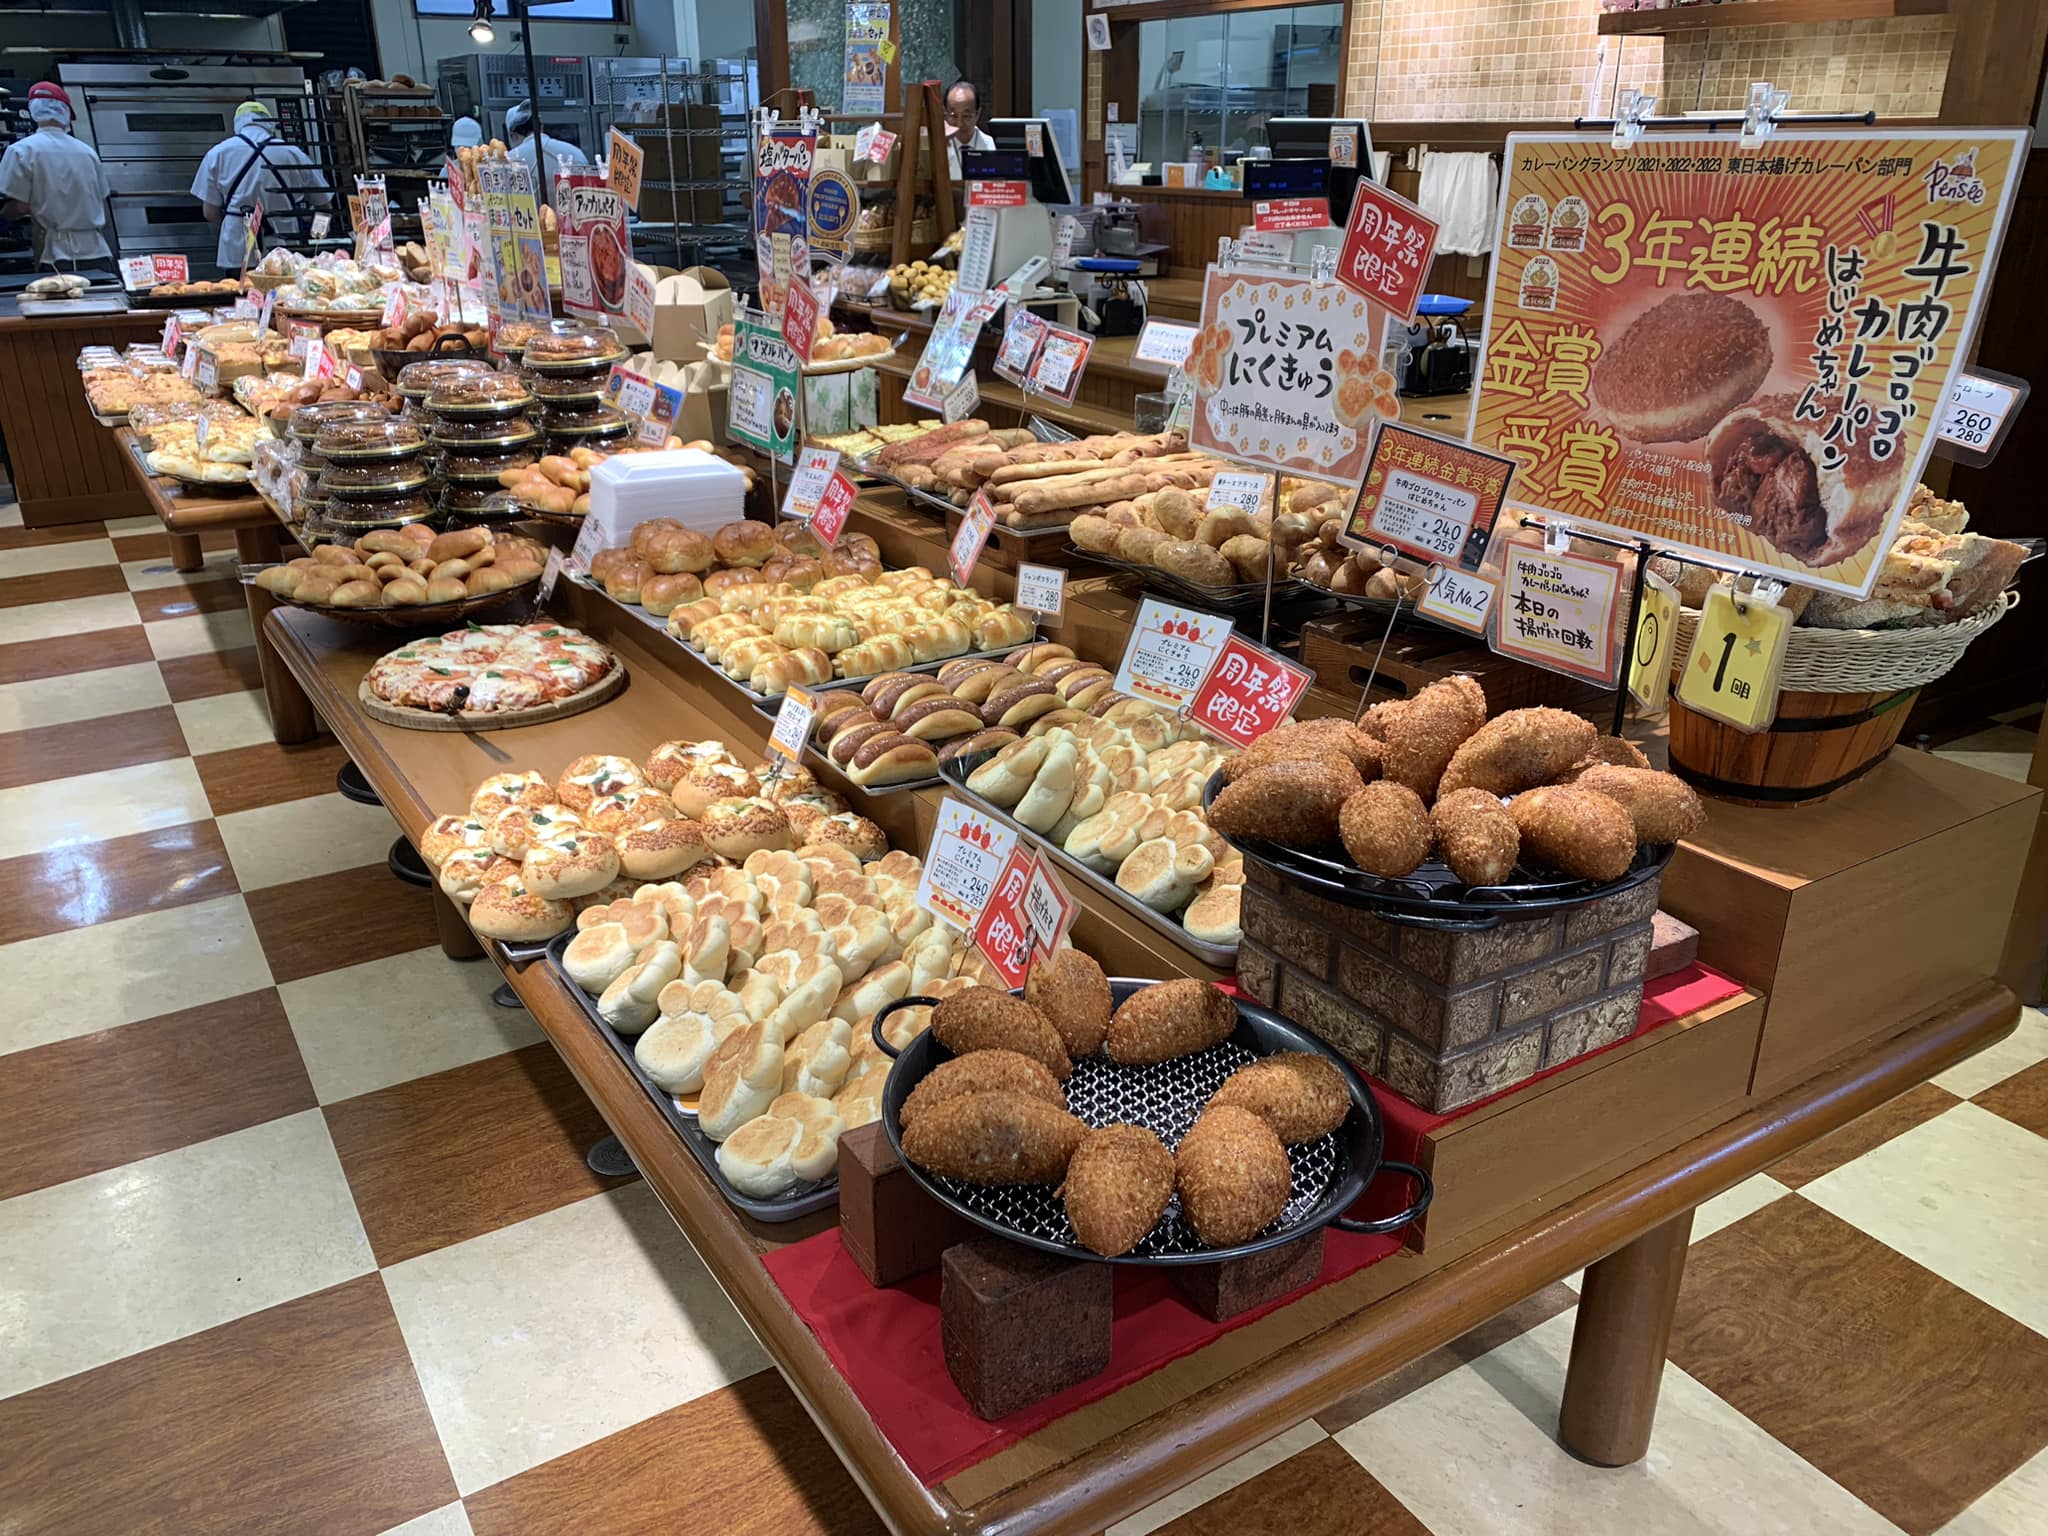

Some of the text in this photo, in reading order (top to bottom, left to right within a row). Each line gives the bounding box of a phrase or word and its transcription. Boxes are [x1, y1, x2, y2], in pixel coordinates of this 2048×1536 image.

[759, 142, 808, 168] 塩バターパン
[1355, 202, 1425, 268] 周年祭
[1590, 202, 1825, 296] 3年連続
[1353, 246, 1405, 296] 限定
[1236, 307, 1334, 353] プレミアム
[1795, 245, 1865, 419] はじめちゃん
[1873, 222, 1970, 458] 牛肉ゴロゴロ
[1229, 352, 1335, 398] にくきゅう
[1482, 319, 1602, 409] 金賞
[1821, 297, 1891, 471] カレーパン
[1953, 409, 1992, 432] 260
[1955, 427, 1983, 444] 280
[1379, 438, 1501, 498] 3年連続金賞受賞
[1499, 417, 1620, 510] 受賞
[1240, 493, 1259, 506] 280
[1394, 477, 1468, 508] 牛肉ゴロゴロカレーパン
[1407, 493, 1447, 512] はじめちゃん
[1432, 518, 1462, 541] 240
[1433, 538, 1456, 555] 259
[1517, 560, 1563, 580] 牛肉ゴロゴロ
[1429, 575, 1489, 613] 人気No.2
[1510, 589, 1560, 621] 本日の
[1160, 639, 1192, 653] プレミアム
[1513, 616, 1594, 650] 揚げたて回数
[1177, 663, 1201, 680] 240
[1178, 677, 1196, 689] 259
[1215, 651, 1293, 713] 周年祭
[1206, 688, 1261, 736] 限定
[969, 876, 989, 897] 240
[970, 893, 985, 908] 259
